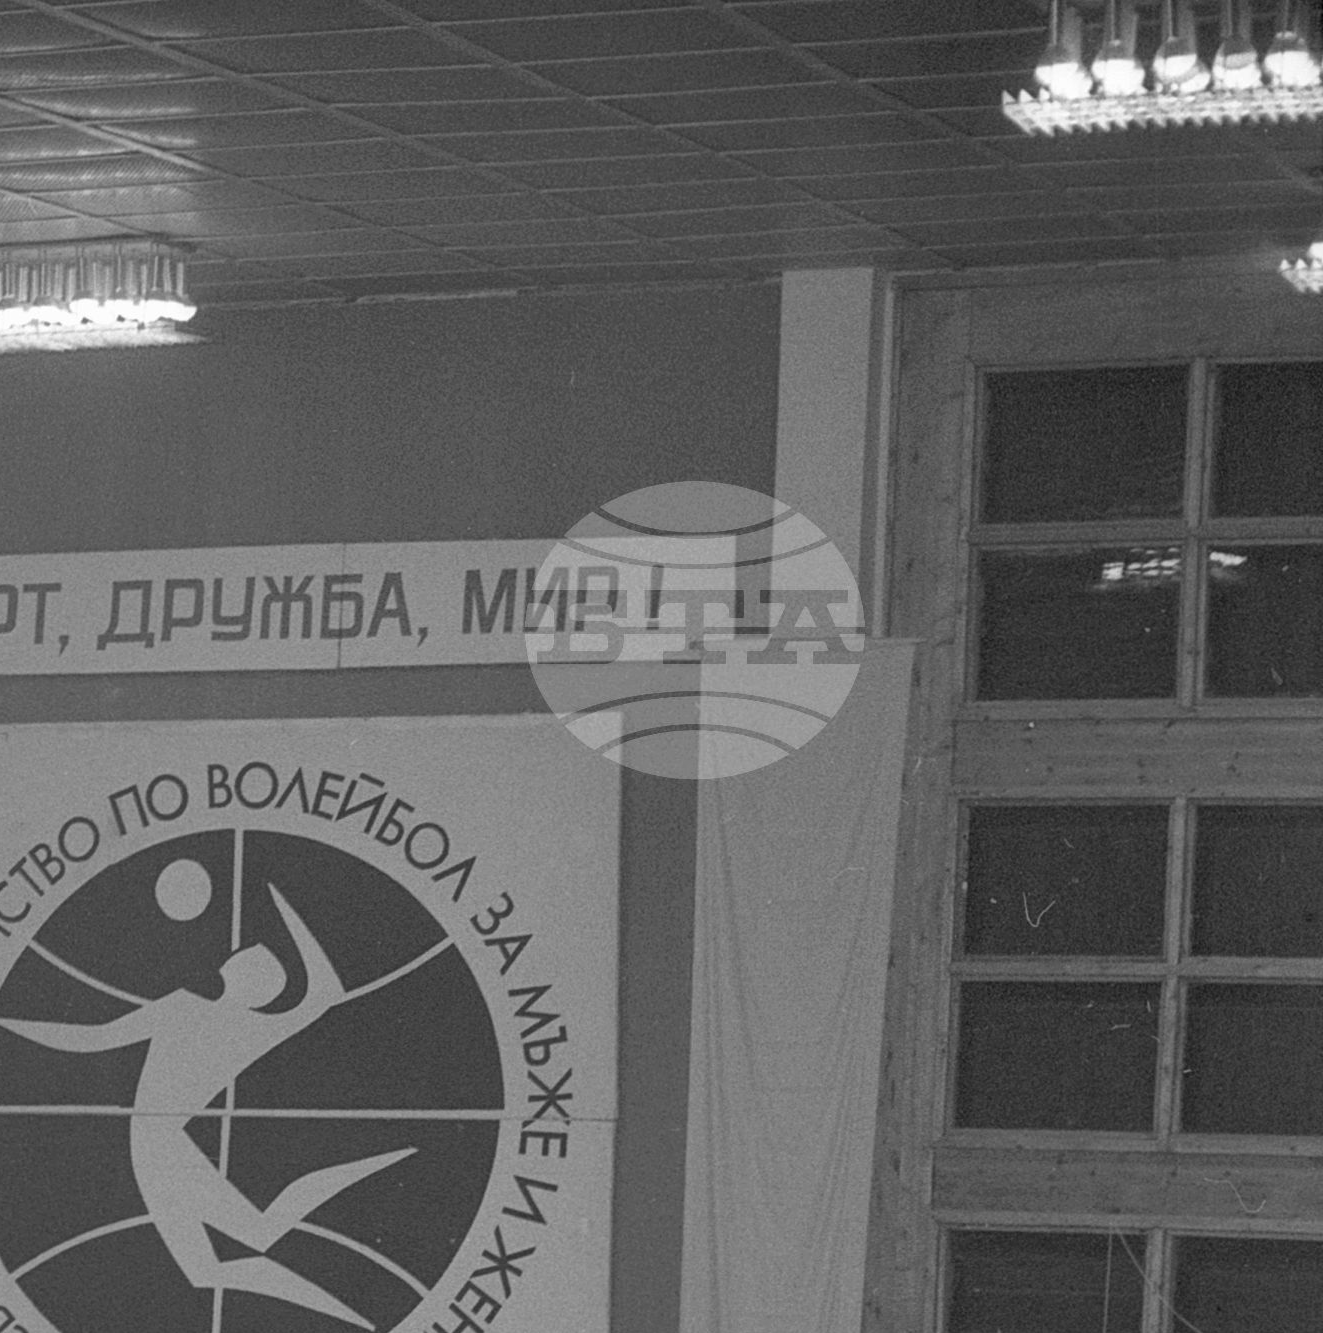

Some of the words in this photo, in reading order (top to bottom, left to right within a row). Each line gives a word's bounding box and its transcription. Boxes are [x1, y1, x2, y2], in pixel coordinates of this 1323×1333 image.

[96, 571, 429, 650] ДРУЖБА,
[109, 774, 188, 836] ПО
[207, 762, 477, 902] ВОЛЕЙБОЛ
[470, 892, 533, 975] ЗА
[508, 984, 573, 1158] МЪЖЕ
[502, 1175, 558, 1225] И
